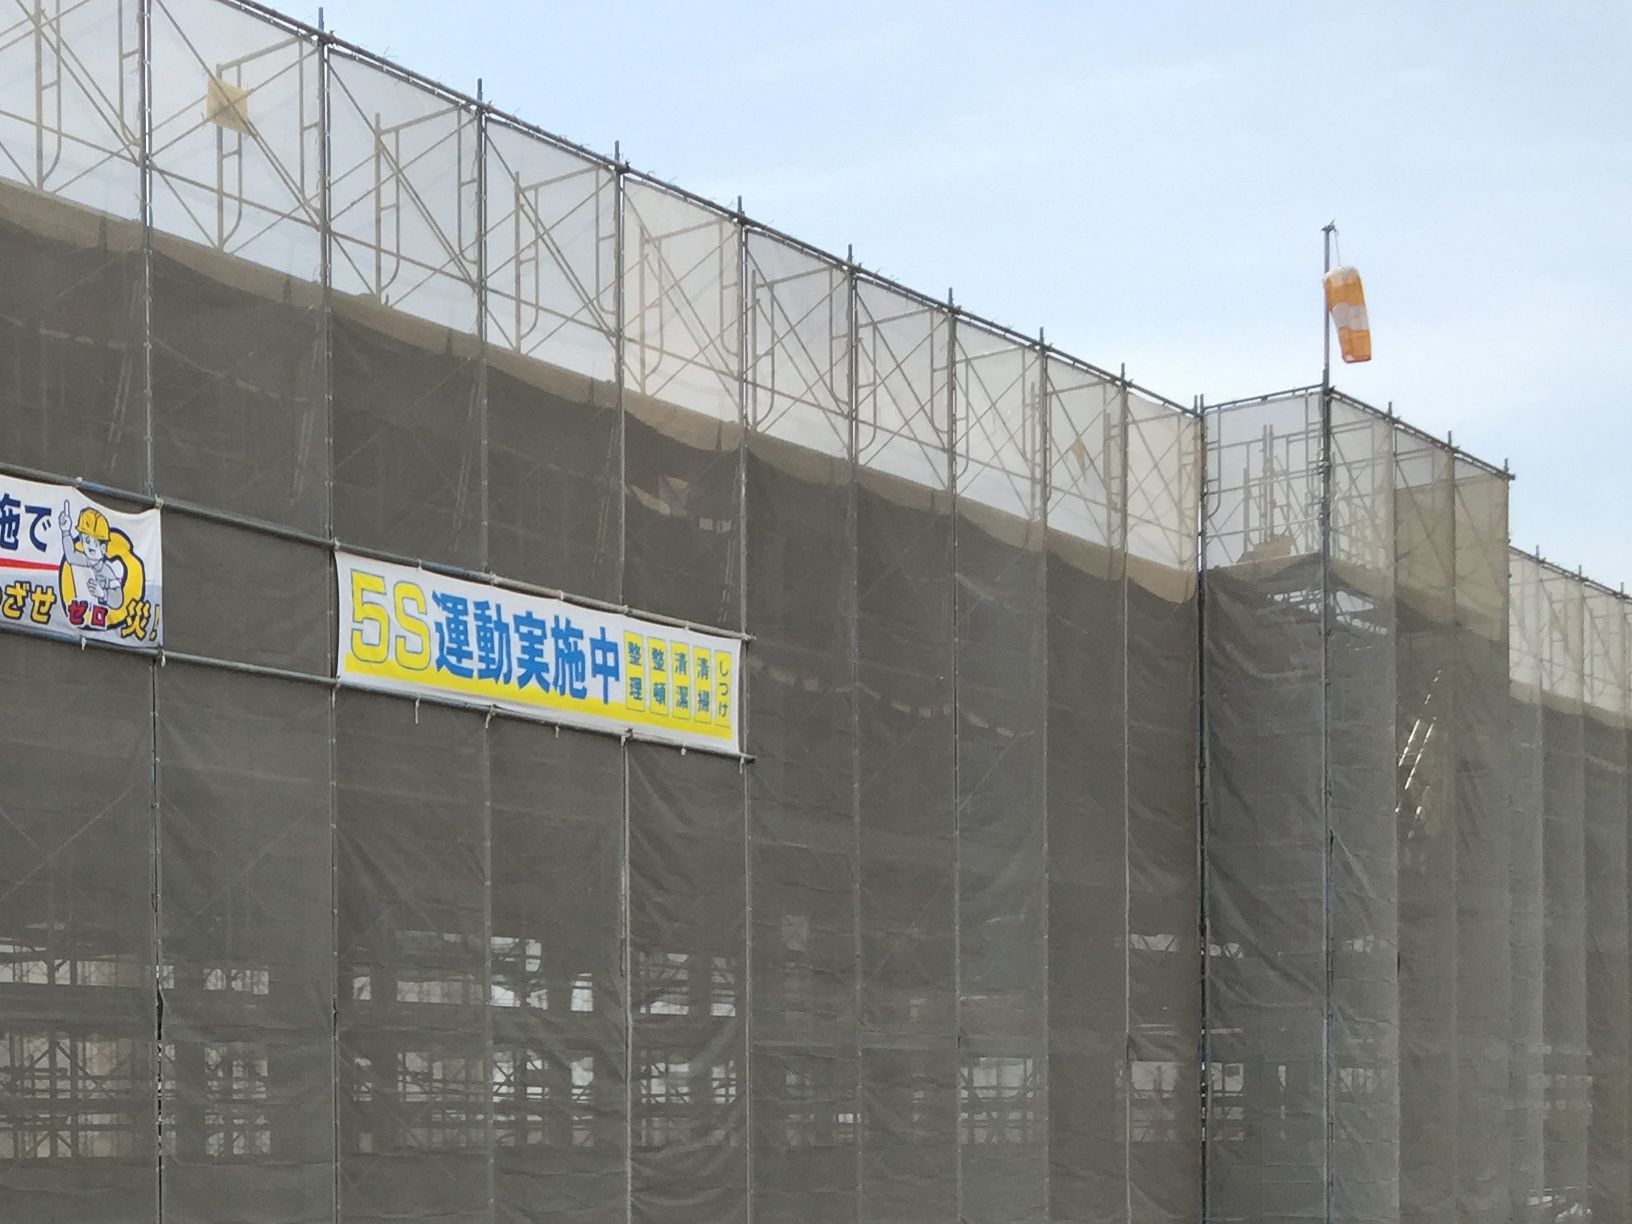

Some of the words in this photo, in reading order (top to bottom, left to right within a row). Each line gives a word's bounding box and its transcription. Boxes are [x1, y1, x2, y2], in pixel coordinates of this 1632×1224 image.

[350, 567, 620, 705] 5S運動実施中
[718, 659, 729, 718] しつけ
